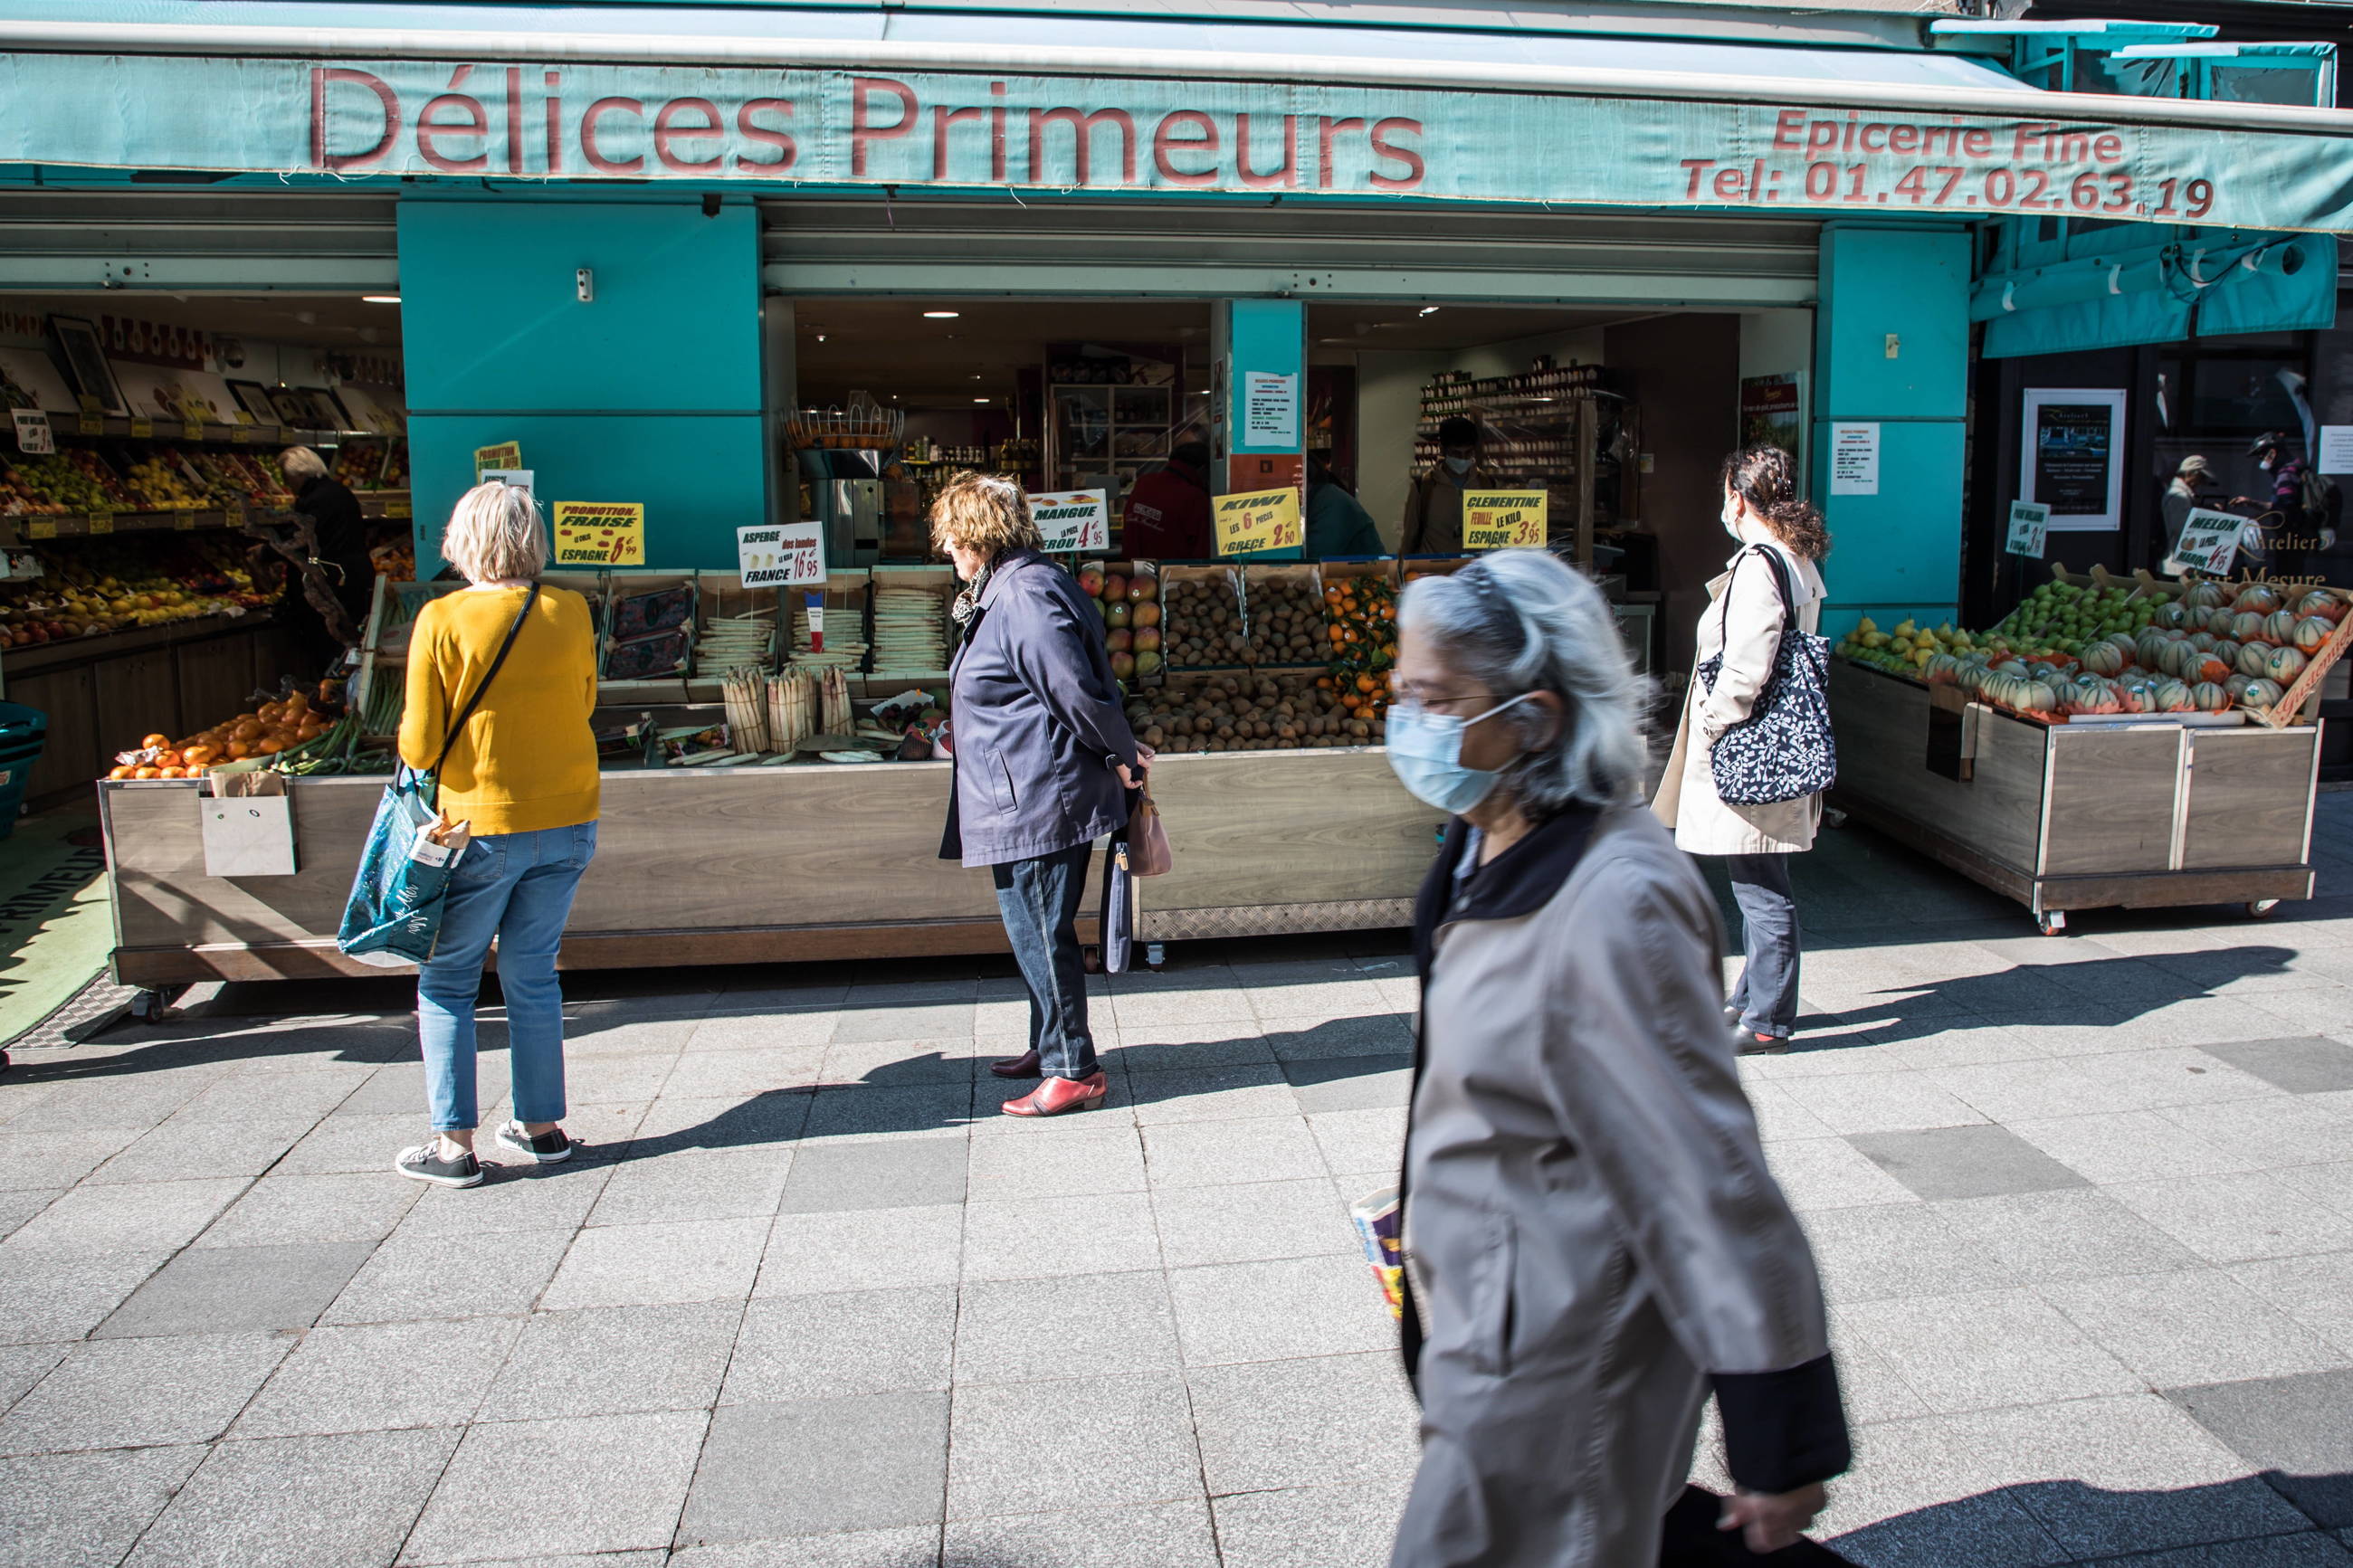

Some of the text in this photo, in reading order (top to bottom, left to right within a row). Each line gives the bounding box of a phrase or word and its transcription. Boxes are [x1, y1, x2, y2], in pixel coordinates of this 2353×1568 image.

[310, 64, 1424, 190] Délices Primeurs
[1772, 109, 2122, 164] Epicerie Fine
[1681, 158, 2215, 219] Tel: 01.47.02.63.19
[1220, 494, 1288, 512] KIWI
[1467, 497, 1542, 508] CLEMENTINE
[562, 506, 634, 516] PROMOTION
[1034, 506, 1098, 521] MANGUE
[1496, 517, 1504, 528] LE
[1505, 510, 1521, 526] KILO
[560, 516, 637, 527] FRAISE
[1230, 522, 1240, 535] LES
[1243, 512, 1253, 530] 6
[2189, 518, 2242, 532] MELON
[743, 531, 780, 544] ASPERGE
[1078, 521, 1090, 548] 4
[1227, 537, 1266, 552] GRECE
[1272, 524, 1283, 546] 2
[1468, 530, 1510, 544] ESPAGNE
[1513, 521, 1529, 545] 3
[1043, 537, 1076, 550] EROU
[561, 549, 609, 561] ESPAGNE
[745, 568, 791, 583] FRANCE
